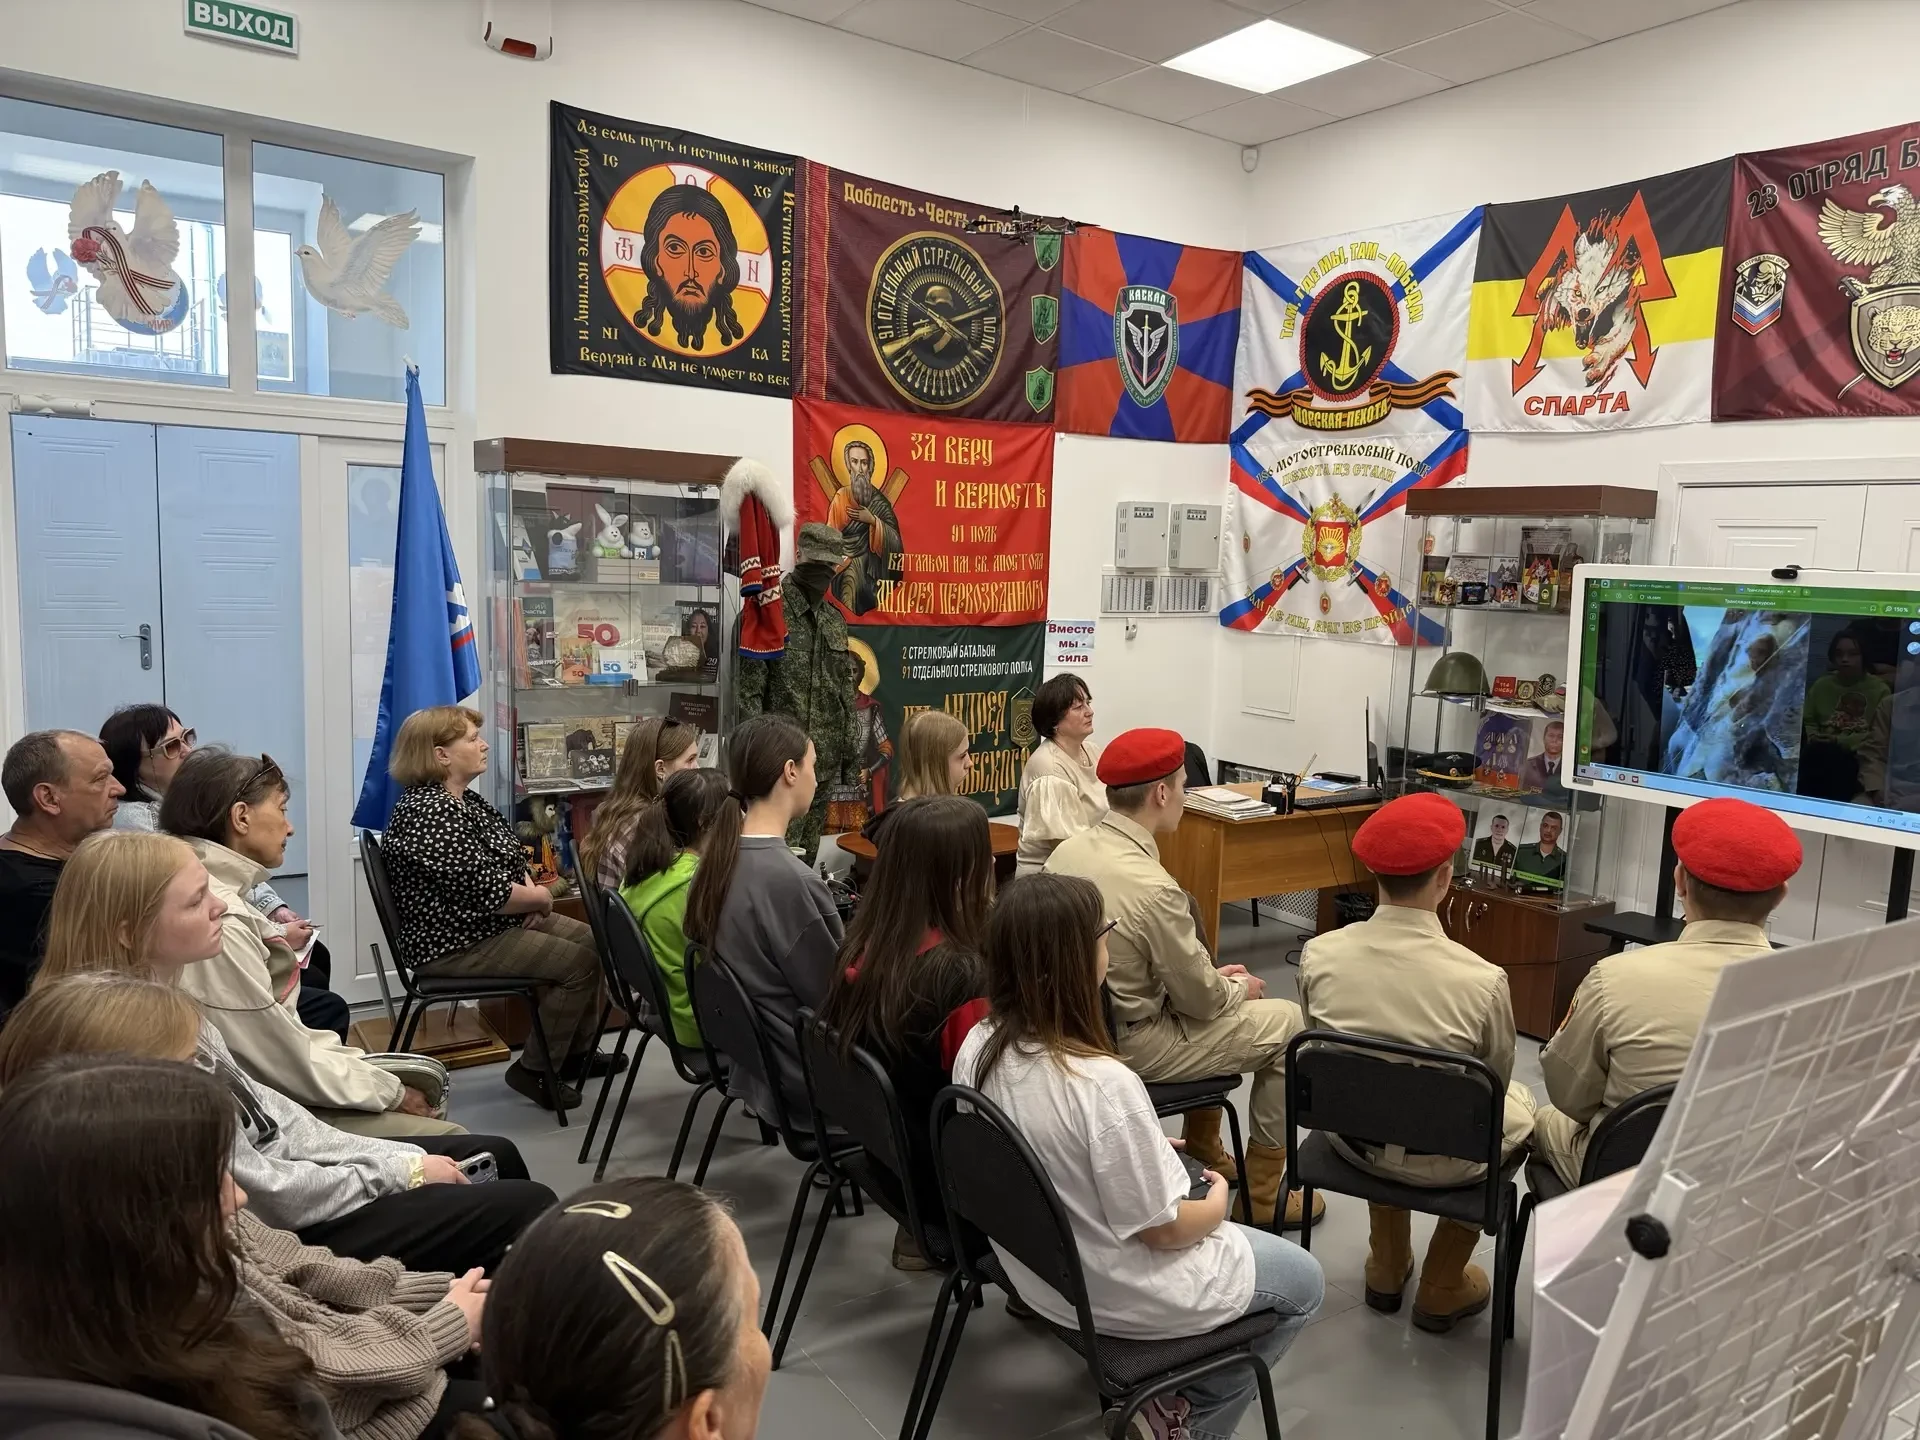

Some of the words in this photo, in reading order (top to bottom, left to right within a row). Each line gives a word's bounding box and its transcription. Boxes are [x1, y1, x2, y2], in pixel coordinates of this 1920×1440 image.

[194, 1, 290, 44] ВЫХОД
[577, 118, 597, 137] Аз
[601, 128, 636, 144] есмь
[640, 136, 674, 152] путь
[679, 143, 687, 156] и
[691, 146, 739, 167] истина
[741, 156, 750, 168] и
[753, 159, 794, 177] живот
[1746, 183, 1780, 219] 23
[1787, 146, 1888, 202] ОТРЯД
[843, 182, 916, 217] Доблесть
[877, 247, 922, 321] ОТДЕЛЬНЫЙ
[922, 247, 995, 303] СТРЕЛКОВЫЙ
[1295, 266, 1321, 300] ГДЕ
[1350, 242, 1379, 261] ТАМ
[1385, 252, 1424, 325] ПОБЕДА!
[1129, 289, 1166, 306] КАСКАД
[878, 323, 894, 340] 91
[979, 315, 997, 353] ПОЛК
[579, 345, 633, 367] Веруяй
[638, 356, 647, 367] в
[652, 355, 677, 371] Мя
[681, 362, 698, 374] не
[702, 365, 745, 381] умрет
[749, 372, 763, 384] во
[767, 374, 790, 387] век
[1293, 404, 1342, 430] МОРСКАЯ
[1346, 403, 1389, 428] ПЕХОТА
[1523, 391, 1629, 418] СПАРТА
[910, 432, 937, 462] ЗА
[945, 435, 994, 467] ВЕРУ
[1276, 444, 1395, 472] МОТОСТРЕЛКОВЫЙ
[1398, 452, 1432, 479] ПОЛК
[1282, 463, 1331, 487] ПЕХОТА
[1332, 463, 1350, 477] ИЗ
[1352, 463, 1396, 484] СТАЛИ
[935, 480, 947, 508] И
[954, 480, 1047, 510] ВЕРНОСТЬ
[951, 524, 965, 543] 91
[970, 524, 998, 543] ПОЛК
[888, 552, 950, 573] БАТАЛЬОН
[993, 552, 1044, 572] АПОСТОЛА
[876, 579, 935, 618] АНДРЕЯ
[939, 579, 1044, 615] ПЕРВОЗВАННОГО
[577, 623, 621, 647] 50
[1048, 623, 1095, 634] Вместе
[902, 646, 907, 660] 2
[908, 642, 959, 660] СТРЕЛКОВЫЙ
[960, 644, 996, 658] БАТАЛЬОН
[1057, 654, 1089, 663] сила
[603, 663, 622, 673] 50
[902, 665, 911, 680] 91
[912, 664, 959, 681] ОТДЕЛЬНОГО
[960, 662, 1010, 677] СТРЕЛКОВОГО
[1010, 660, 1033, 675] ПОЛКА
